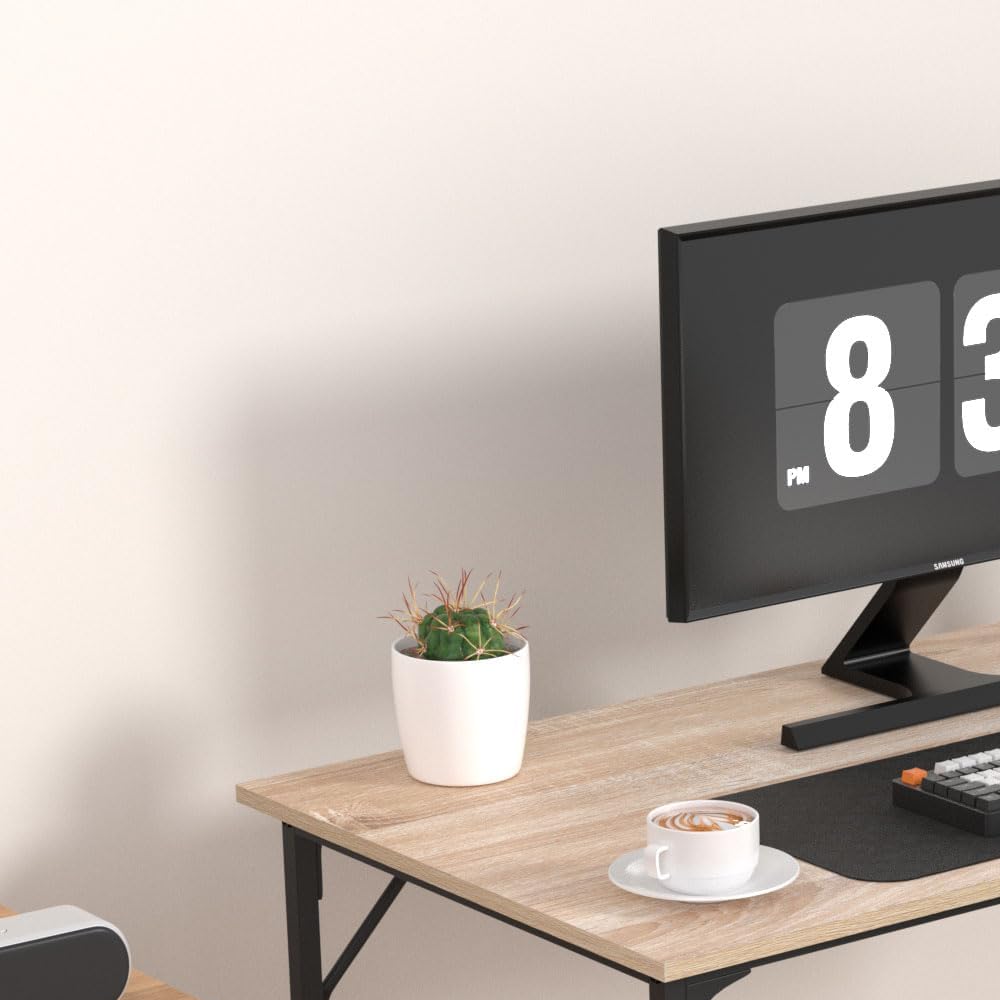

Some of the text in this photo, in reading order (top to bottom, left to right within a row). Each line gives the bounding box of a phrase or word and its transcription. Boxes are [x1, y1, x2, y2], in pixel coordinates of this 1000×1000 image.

[823, 314, 895, 478] 8
[786, 465, 810, 487] PM
[933, 558, 965, 570] SAMSUNG
